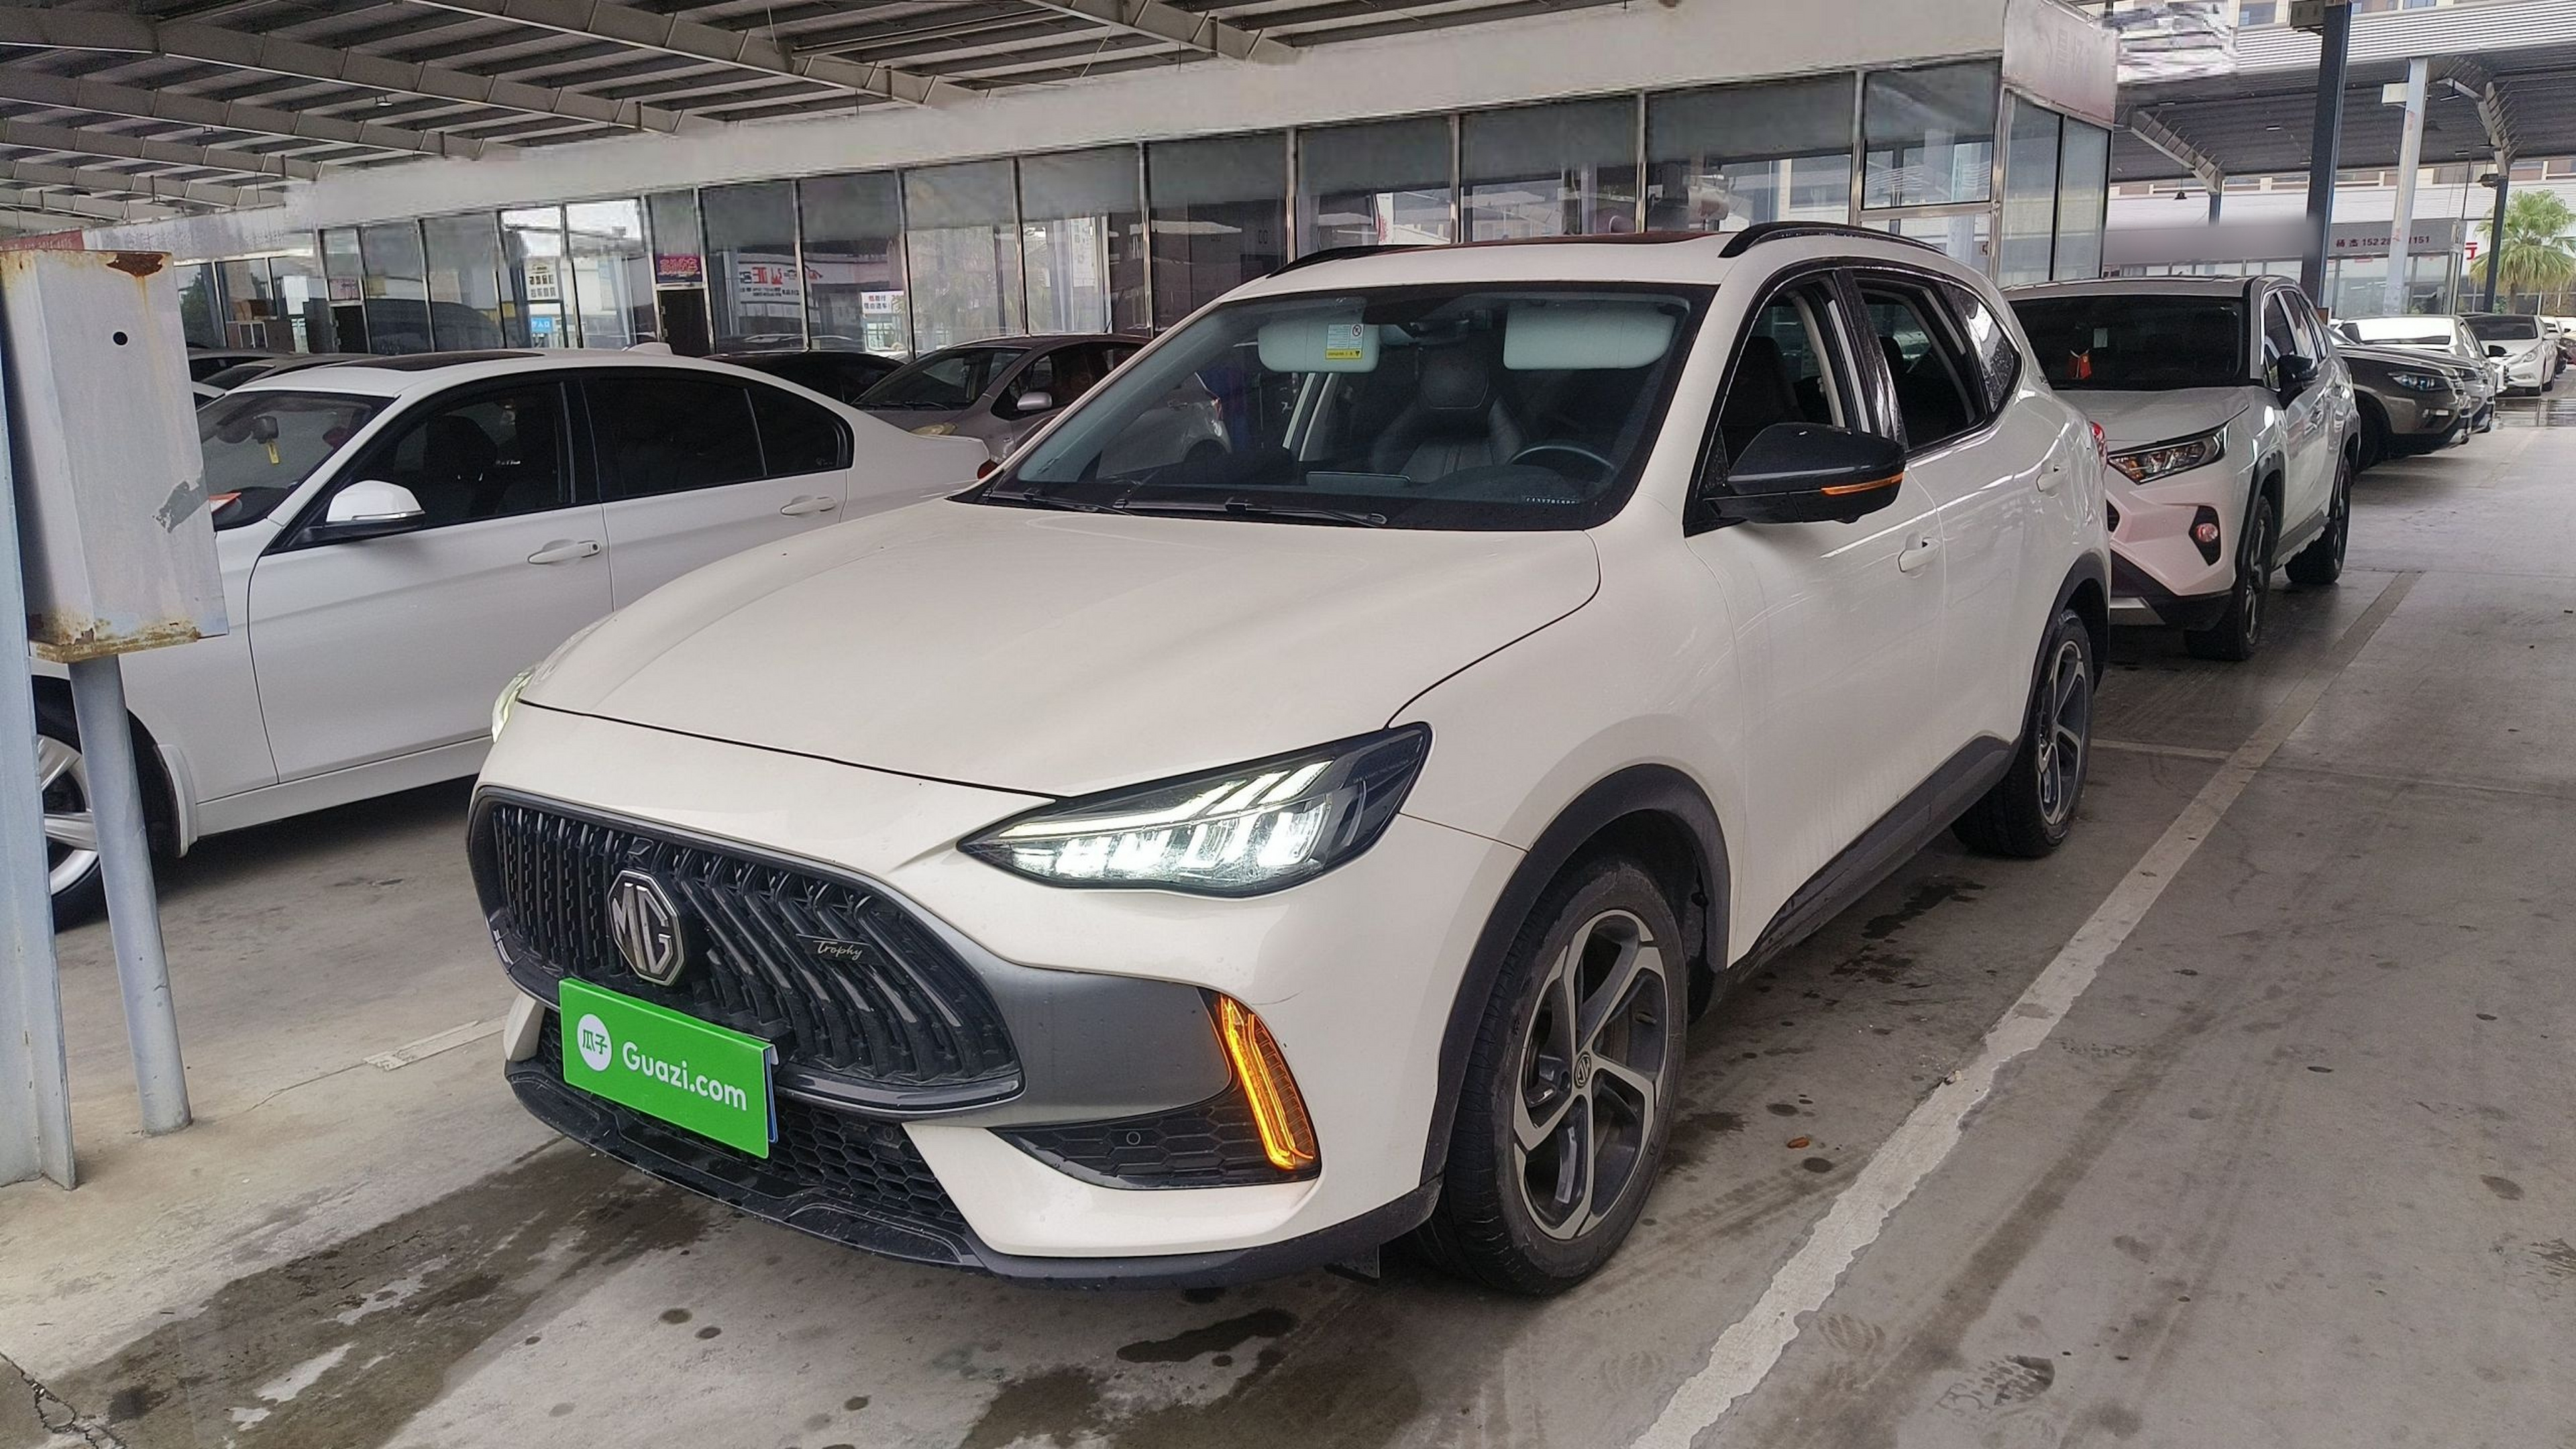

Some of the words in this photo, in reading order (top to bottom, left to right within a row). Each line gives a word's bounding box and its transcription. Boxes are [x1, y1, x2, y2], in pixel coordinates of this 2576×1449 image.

[612, 882, 674, 975] MG
[812, 940, 863, 961] Trophy
[582, 1028, 608, 1056] 瓜子
[622, 1040, 748, 1112] Guazi.com
